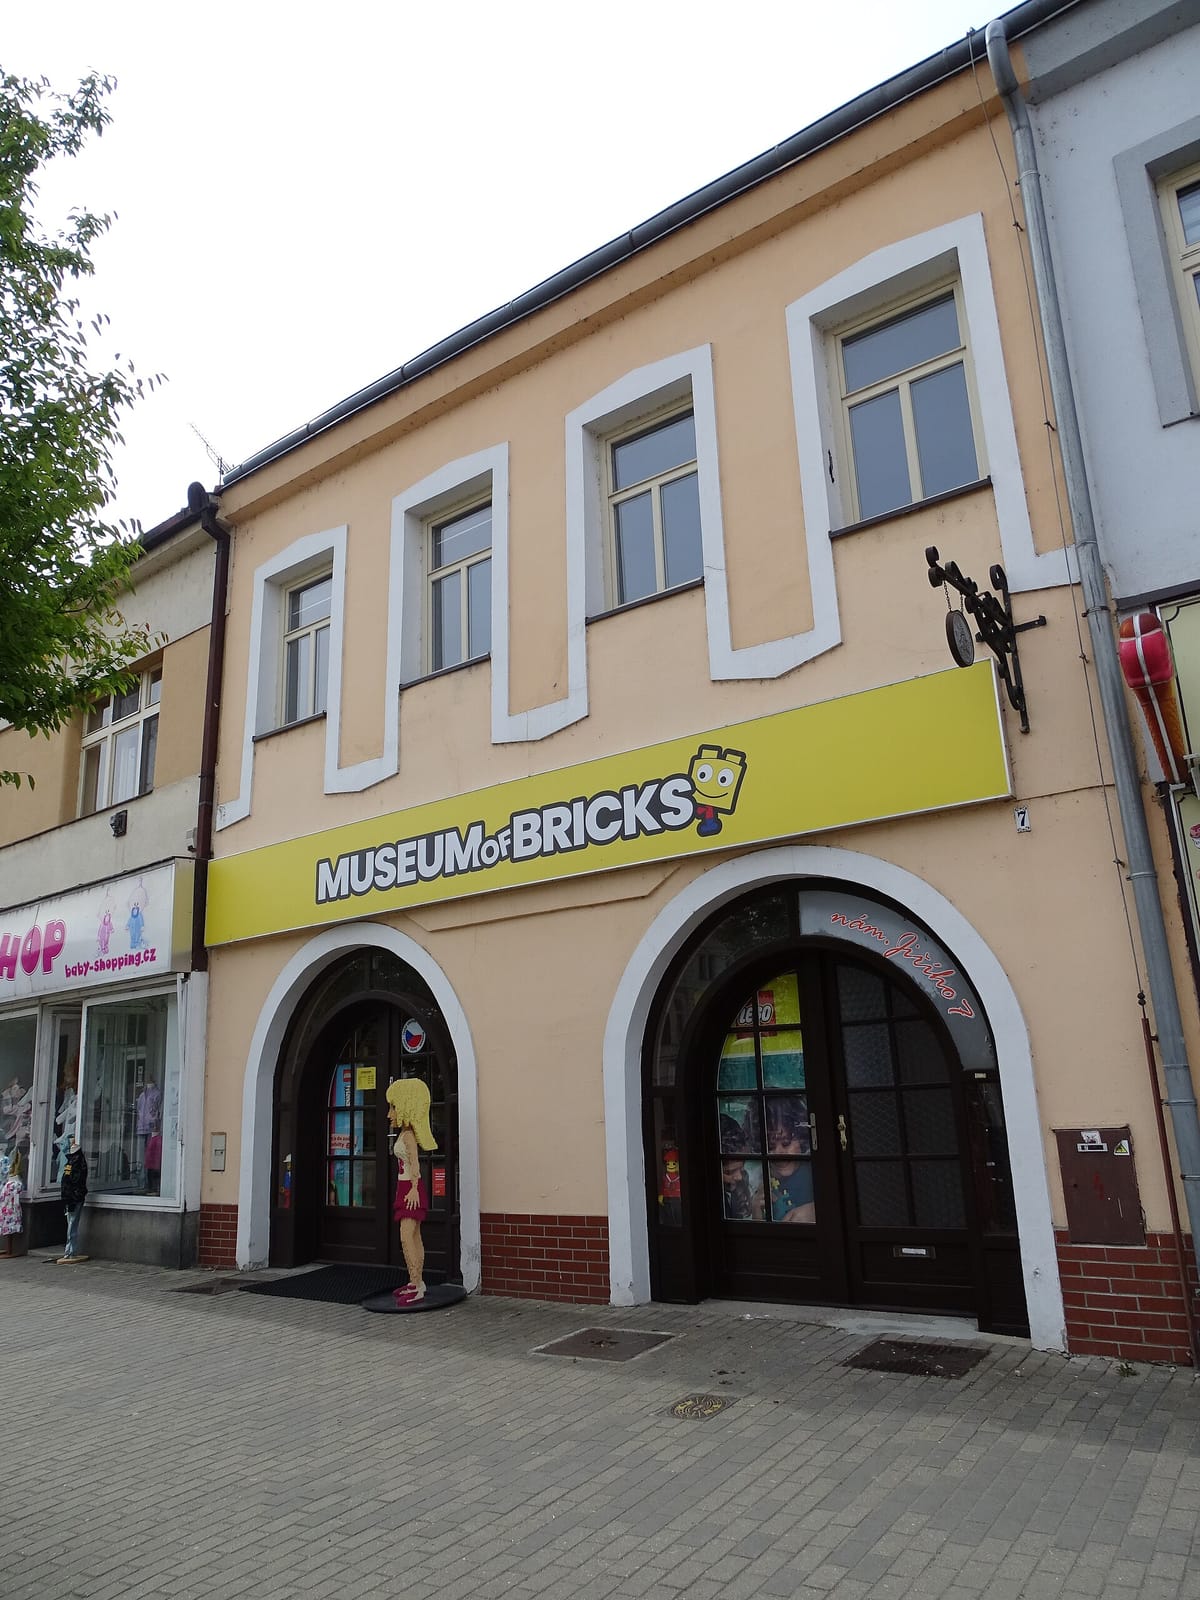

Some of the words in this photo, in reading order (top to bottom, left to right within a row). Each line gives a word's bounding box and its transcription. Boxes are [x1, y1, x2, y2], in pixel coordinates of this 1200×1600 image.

[317, 824, 484, 902] MUSEUM
[480, 828, 512, 865] OF
[512, 777, 695, 860] BRICKS
[1017, 810, 1026, 826] 7
[831, 912, 890, 945] nám.
[948, 998, 976, 1019] 7
